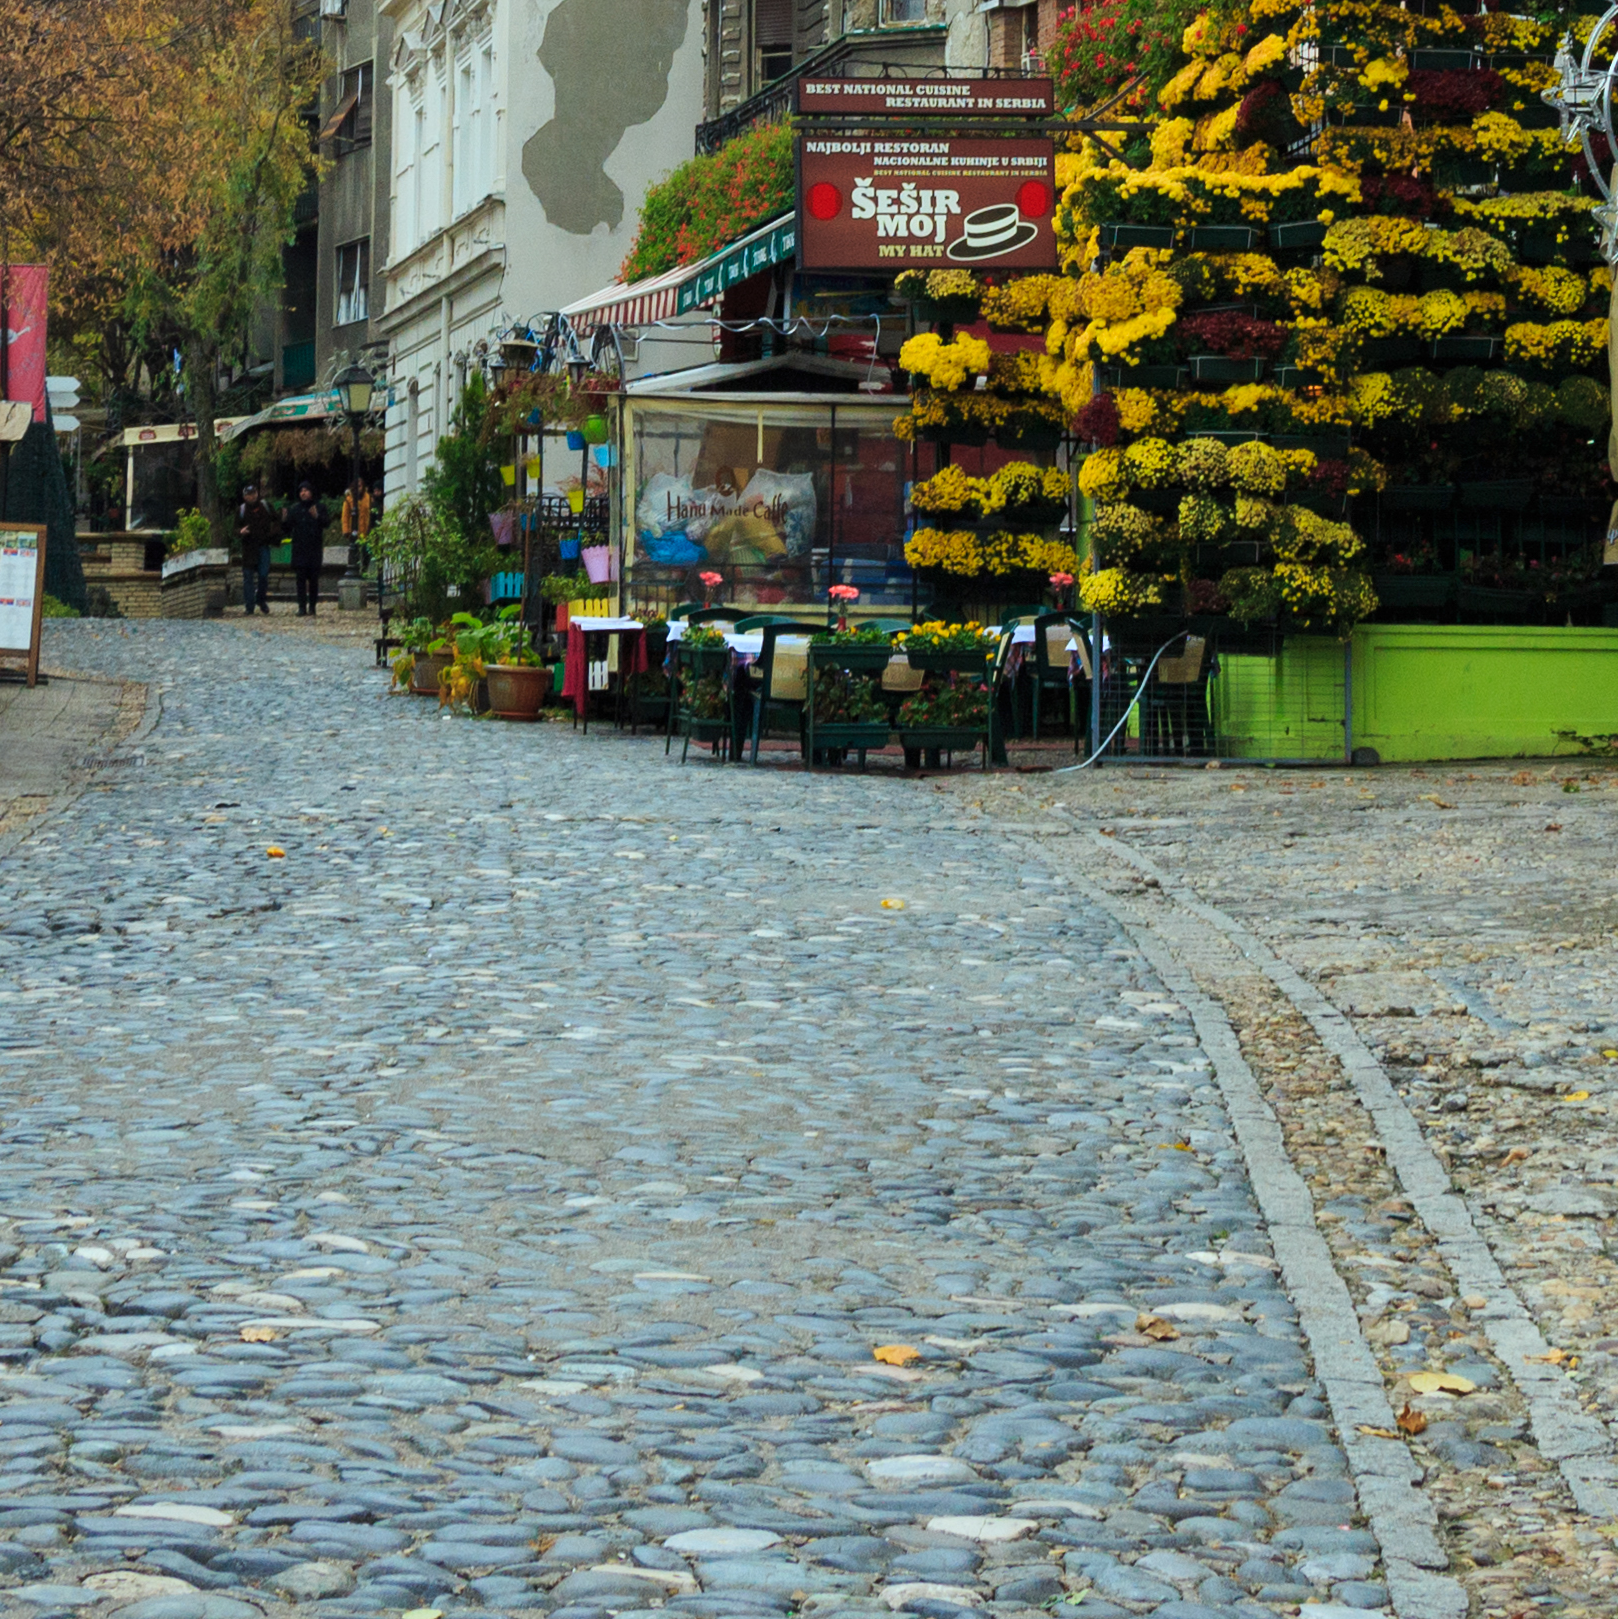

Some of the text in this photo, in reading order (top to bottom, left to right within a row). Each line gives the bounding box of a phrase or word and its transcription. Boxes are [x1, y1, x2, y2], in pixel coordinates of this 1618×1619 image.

[805, 84, 971, 95] BEST NATIONAL CUISINE
[885, 97, 1046, 108] RESTAURANT IN SERBIA
[806, 142, 950, 155] NAJBOLJI RESTORAN
[873, 156, 1048, 168] NACIONALNE KUHINJE U SRBIJI
[851, 177, 961, 219] ŠEŠIR
[876, 214, 947, 243] MOJ
[878, 245, 945, 257] MY HAT
[667, 490, 789, 523] Hand Made Caffe
